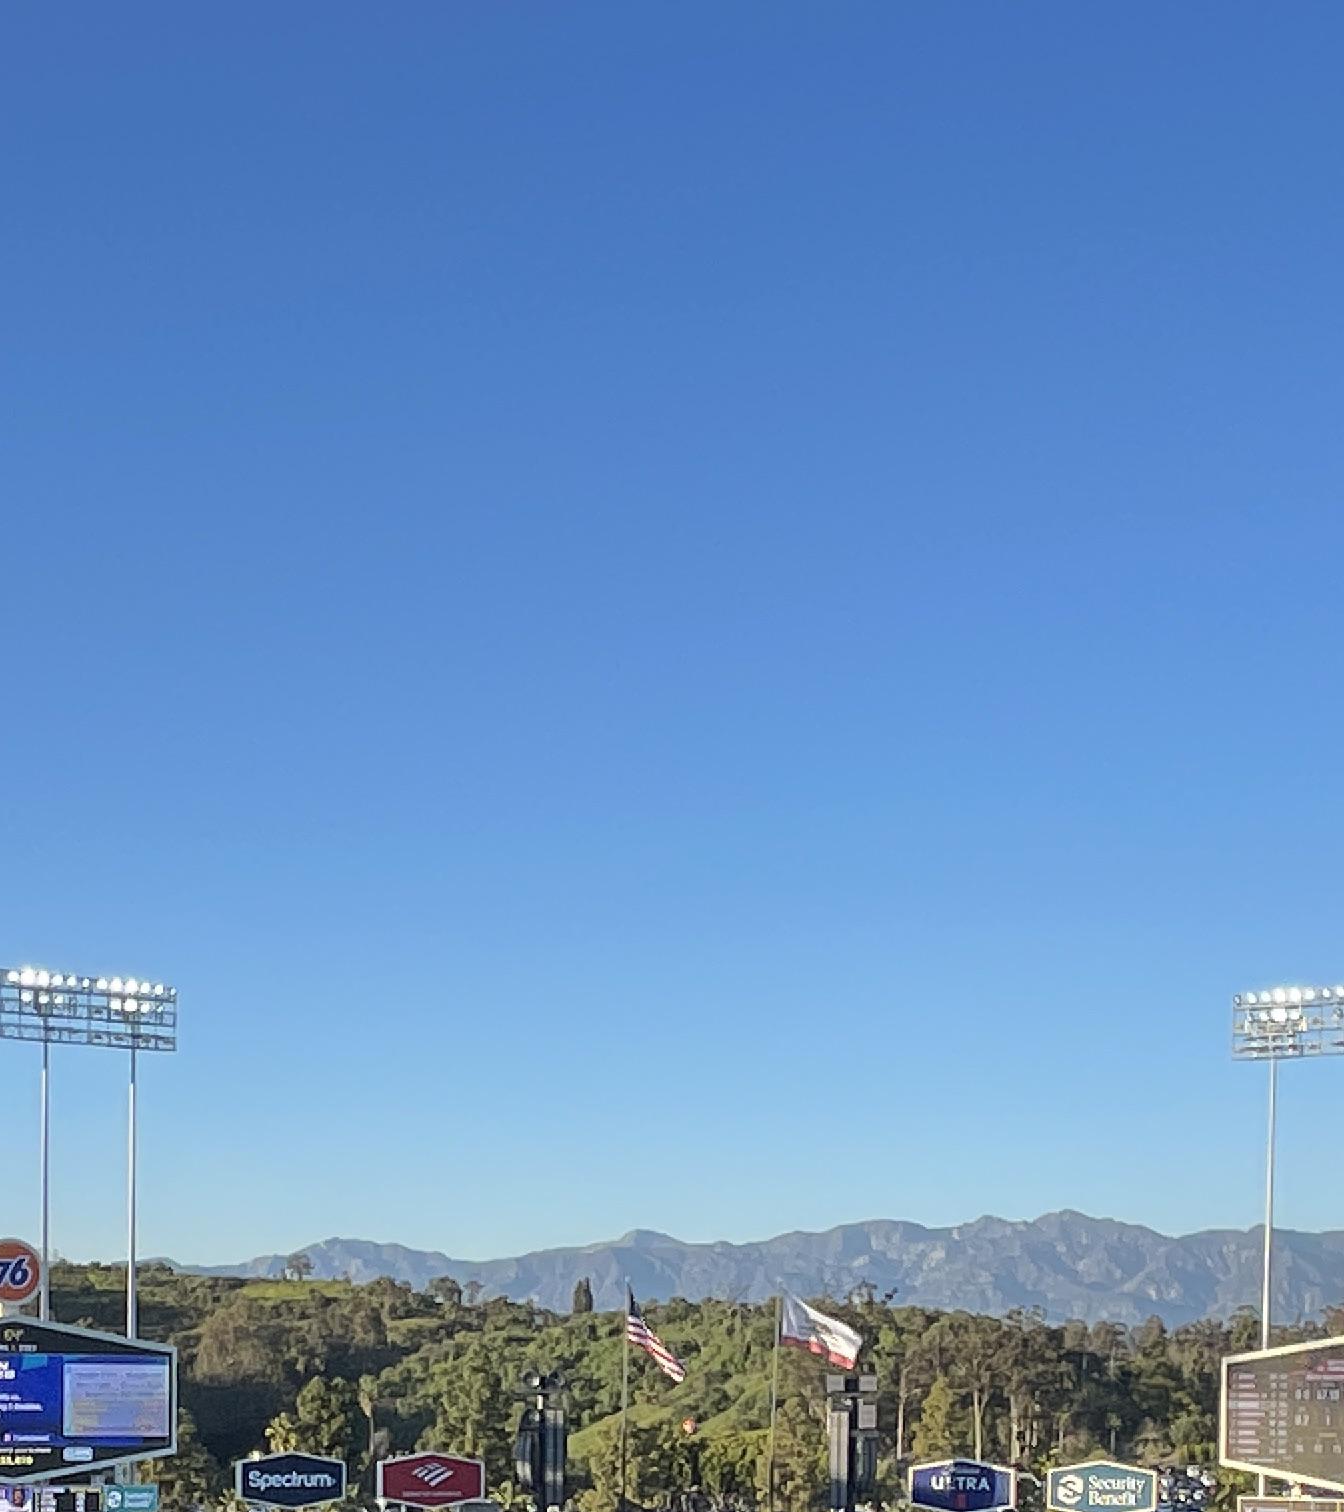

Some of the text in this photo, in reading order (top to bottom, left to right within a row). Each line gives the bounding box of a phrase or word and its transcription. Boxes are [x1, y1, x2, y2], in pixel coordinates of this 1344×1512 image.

[248, 1470, 332, 1491] Spectrum
[930, 1475, 991, 1491] ULTRA
[1088, 1474, 1146, 1494] Security
[1088, 1490, 1141, 1506] Benefit
